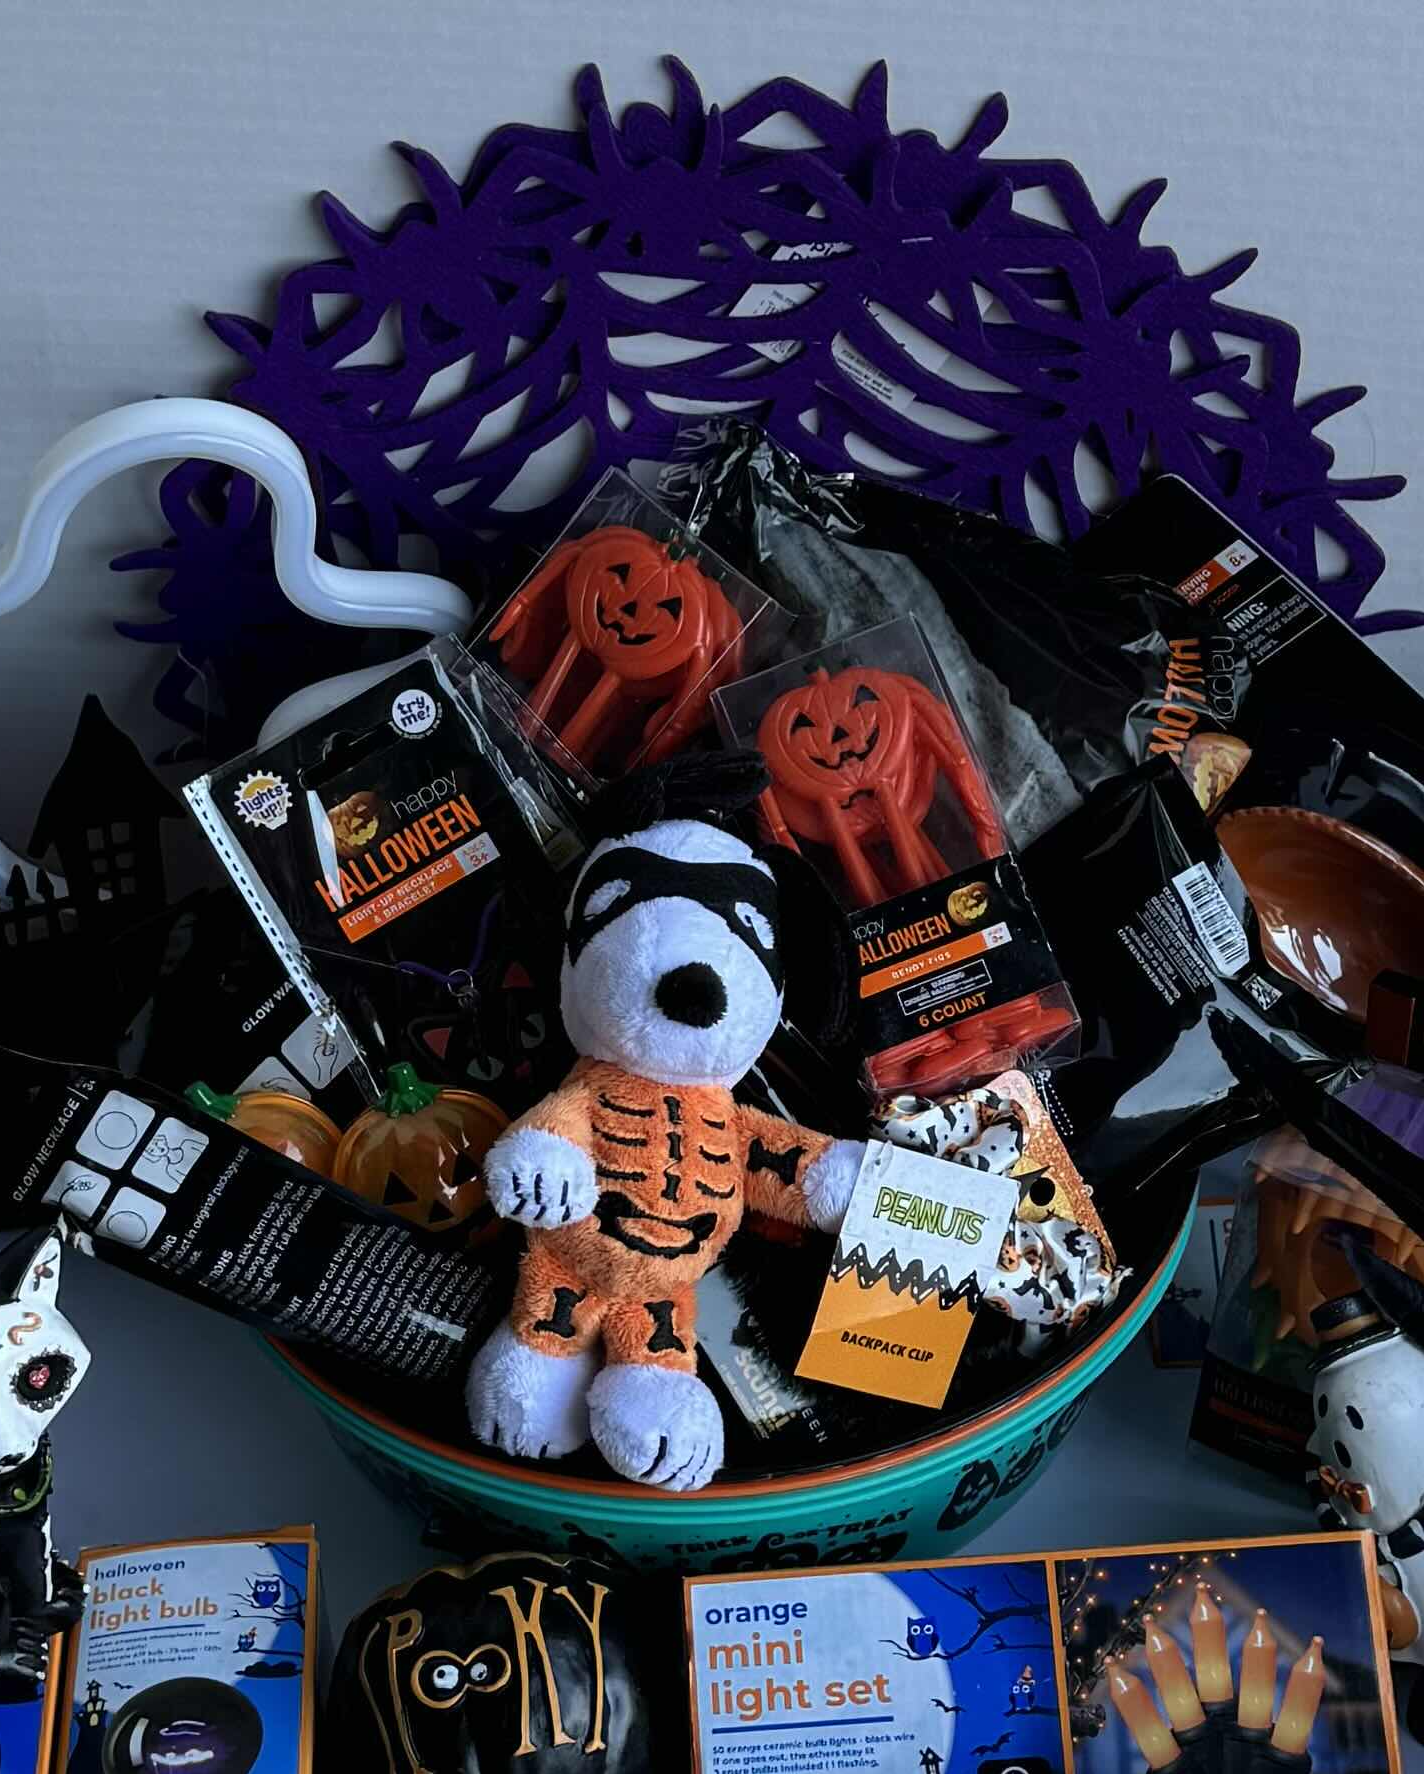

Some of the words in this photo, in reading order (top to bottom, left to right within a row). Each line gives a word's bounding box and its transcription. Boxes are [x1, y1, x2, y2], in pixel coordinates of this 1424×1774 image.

[397, 695, 425, 716] try
[400, 705, 431, 727] me!
[241, 786, 282, 814] lights
[391, 770, 457, 819] happy
[315, 794, 481, 912] HALLOWEEN
[346, 893, 395, 928] LIGHT-UP
[396, 859, 453, 894] NECKLACE
[383, 882, 436, 917] BRACELET
[858, 913, 952, 966] ALLOWEEN
[242, 998, 275, 1032] GLOW
[919, 1015, 929, 1027] 6
[932, 992, 987, 1022] COUNT
[12, 1161, 43, 1202] GLOW
[35, 1098, 81, 1168] NECKLACE
[874, 1185, 986, 1245] PEANUTS
[840, 1329, 907, 1358] BACKPACK
[908, 1346, 935, 1363] CLIP
[665, 1534, 753, 1555] TRICK
[827, 1508, 913, 1538] TREAT
[95, 1560, 185, 1581] halloween
[93, 1577, 164, 1605] black
[90, 1604, 151, 1631] light
[160, 1597, 219, 1619] bulb
[705, 1598, 808, 1628] orange
[708, 1630, 805, 1671] mini
[711, 1677, 812, 1722] light
[825, 1674, 891, 1708] set
[722, 1756, 740, 1765] one
[743, 1755, 766, 1765] goes
[790, 1751, 807, 1760] the
[809, 1749, 840, 1759] others
[843, 1747, 863, 1758] stay
[764, 1740, 802, 1751] ceramic
[805, 1738, 827, 1747] bulb
[829, 1737, 857, 1748] lights
[865, 1735, 891, 1744] black
[894, 1733, 915, 1741] wire
[752, 1764, 778, 1774] bulbs
[781, 1761, 823, 1772] included
